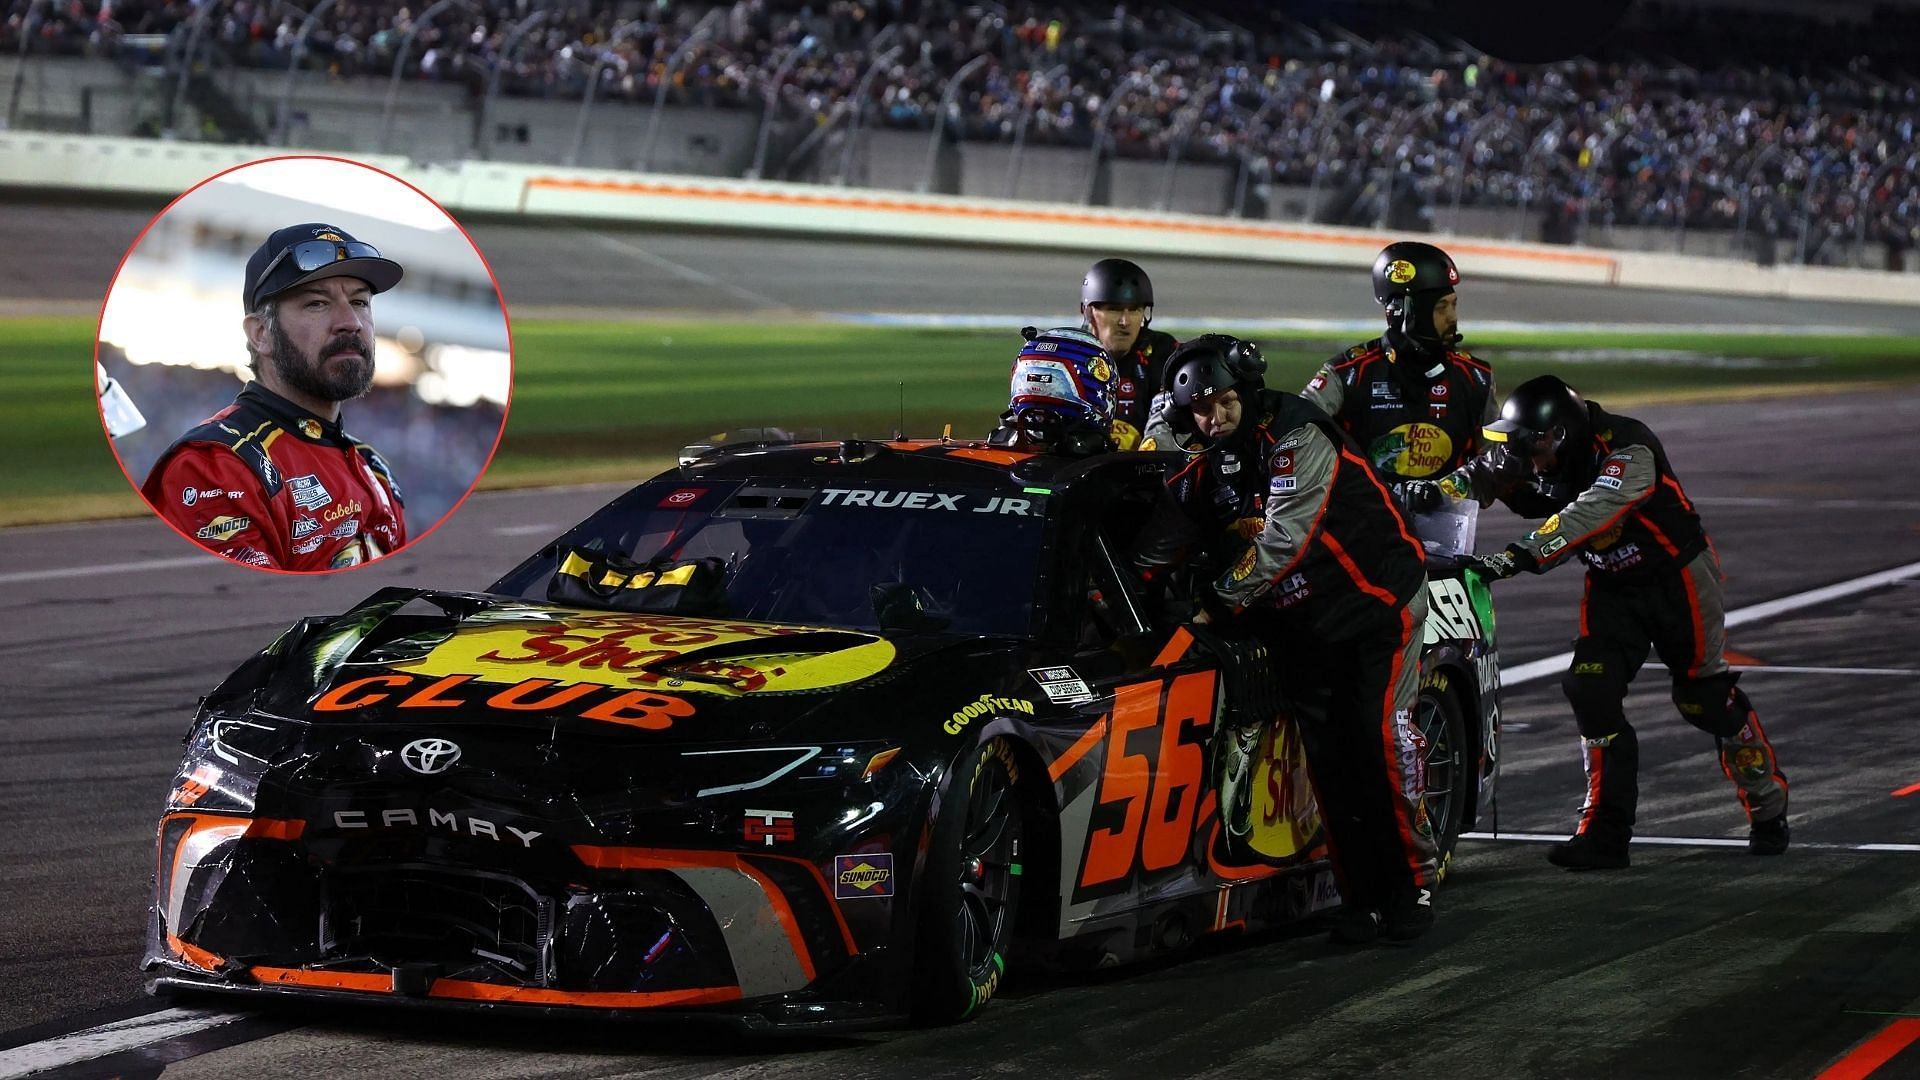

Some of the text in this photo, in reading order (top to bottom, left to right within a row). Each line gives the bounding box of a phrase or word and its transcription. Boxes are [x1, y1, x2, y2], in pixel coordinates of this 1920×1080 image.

[1408, 424, 1440, 439] Bass
[1409, 439, 1432, 453] Pro
[1408, 452, 1446, 469] Shops
[820, 488, 967, 511] TRUEX
[199, 517, 249, 537] SUNOCO
[1061, 682, 1083, 693] SERIES
[312, 674, 698, 732] CLUB
[943, 693, 1035, 735] GOODYEAR
[1079, 669, 1217, 888] 56
[333, 807, 544, 848] CAMRY
[840, 869, 890, 883] SUNOCO
